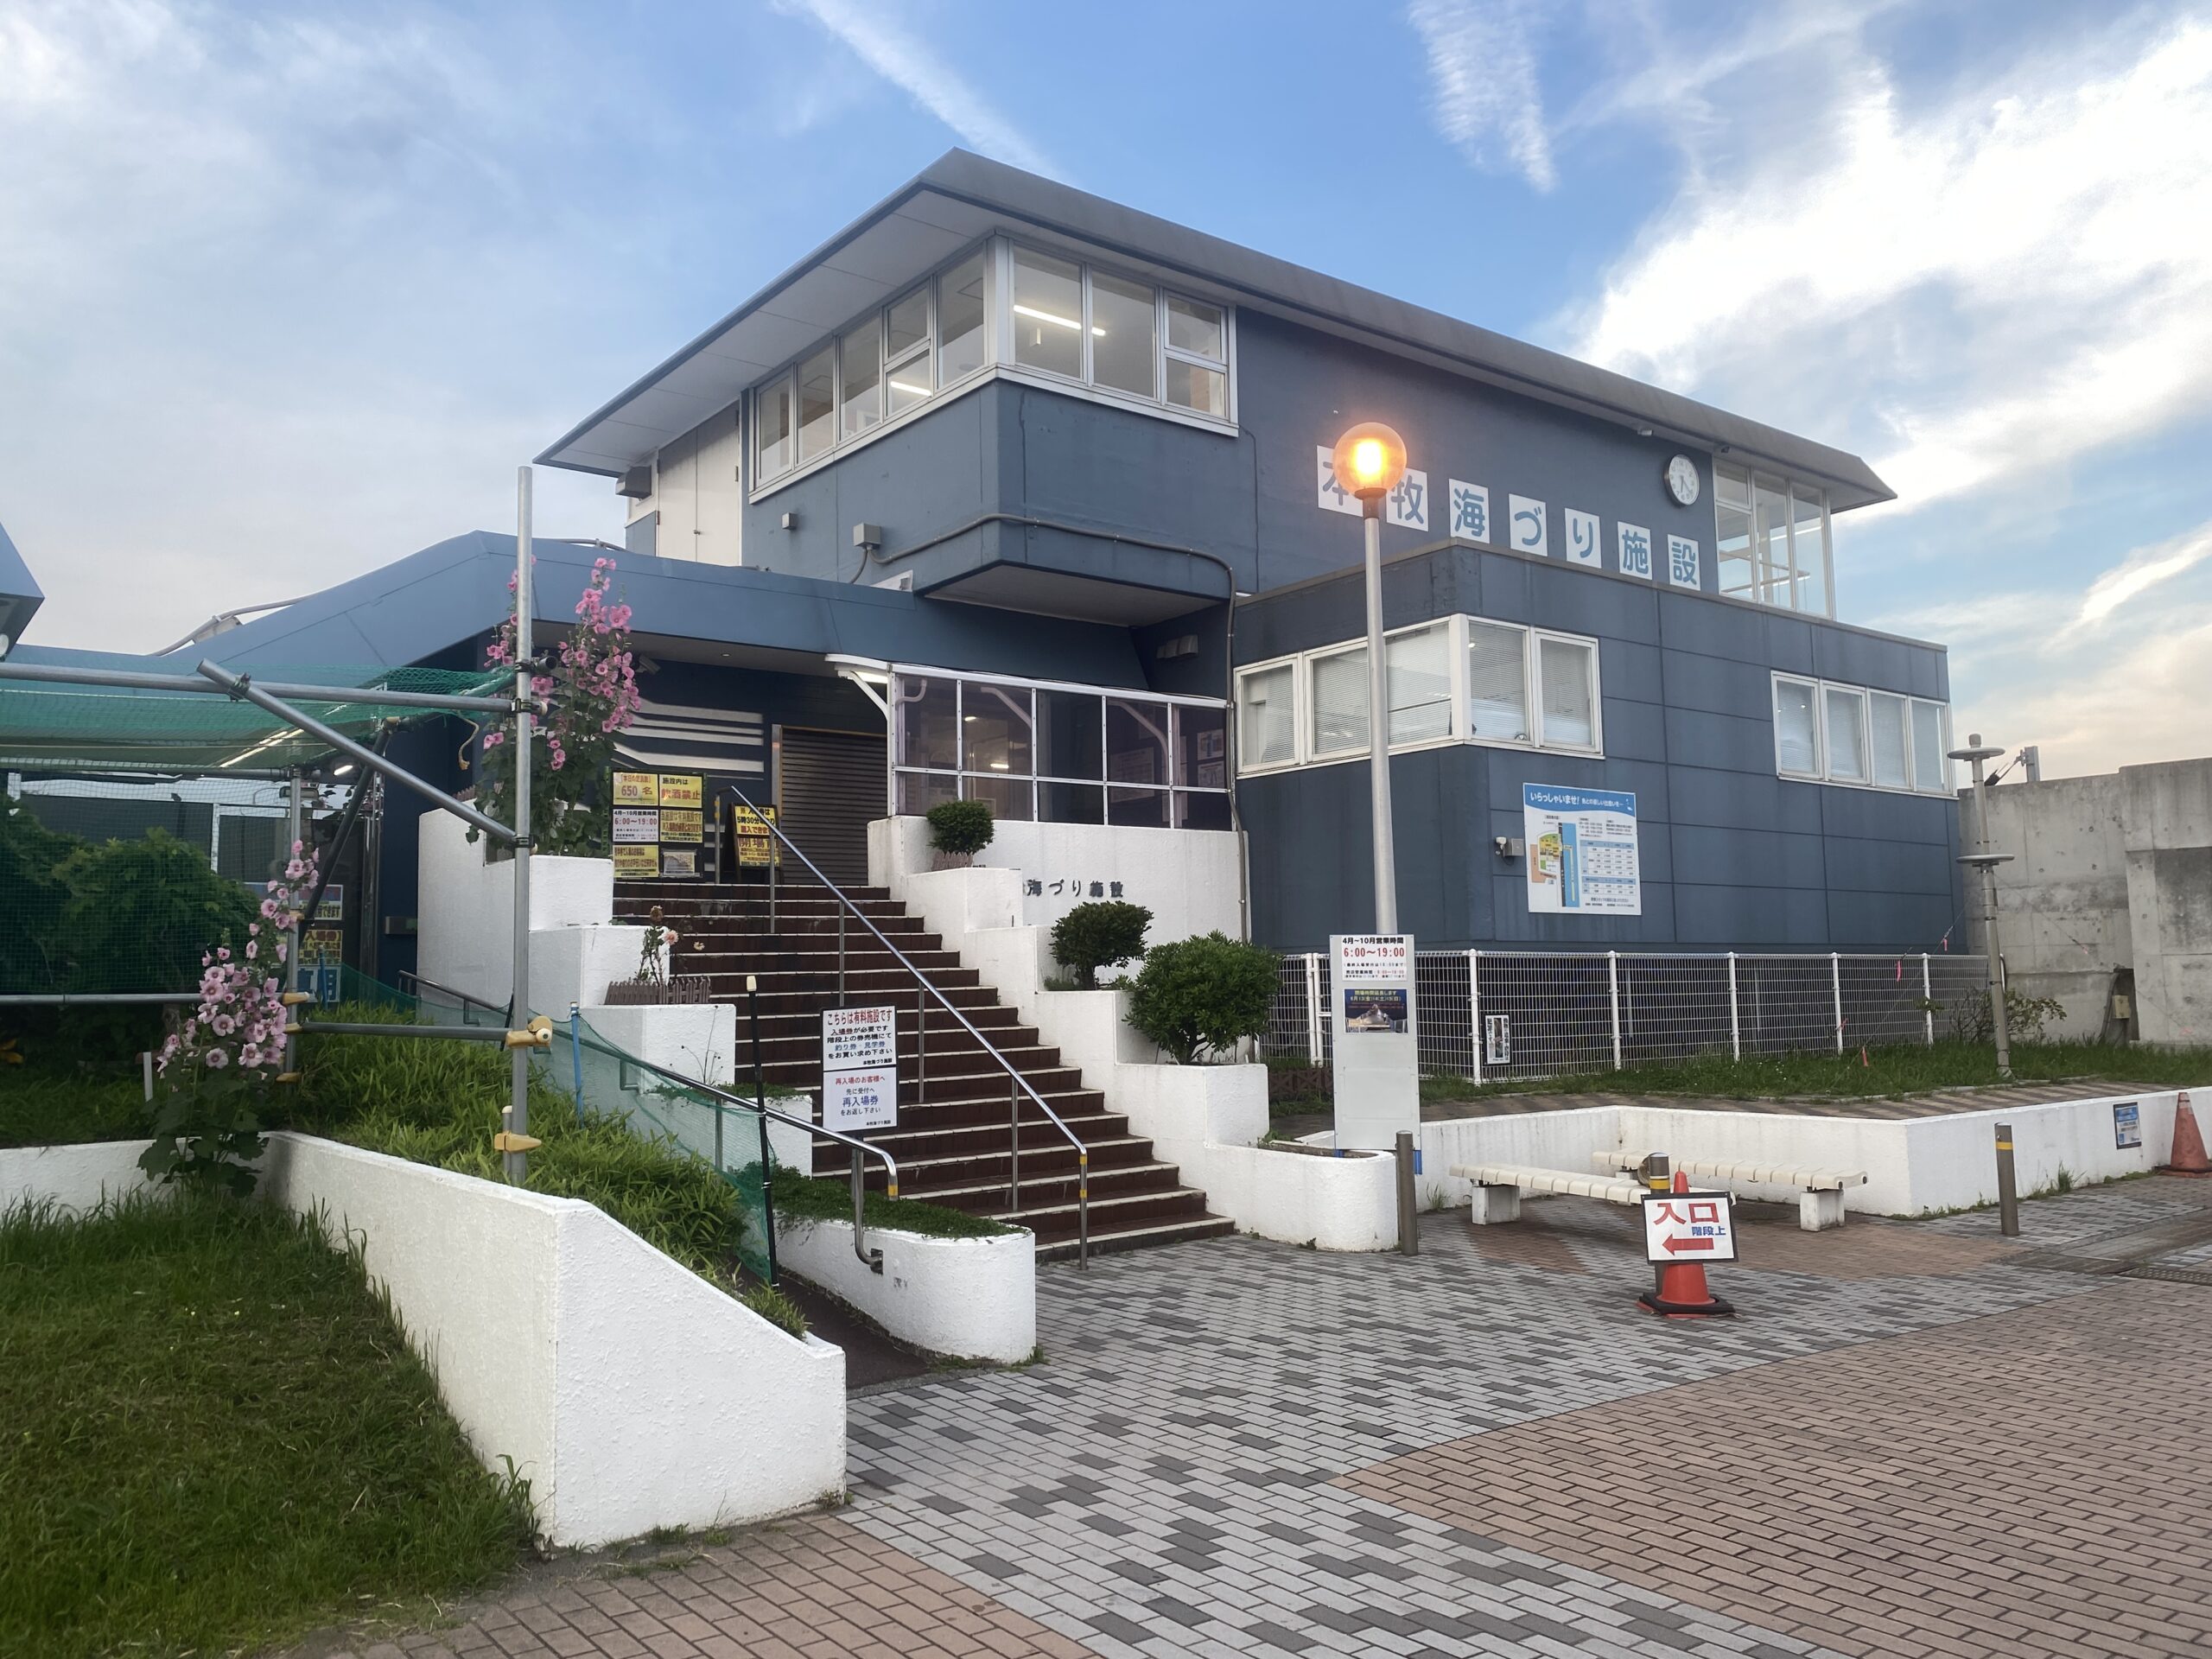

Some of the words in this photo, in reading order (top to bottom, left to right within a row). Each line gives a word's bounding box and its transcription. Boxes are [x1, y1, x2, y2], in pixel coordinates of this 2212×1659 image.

[622, 785, 638, 796] 650
[642, 786, 652, 795] 名
[827, 1009, 893, 1026] こちらは有料施設です
[830, 1025, 888, 1035] 入場券が必要です
[827, 1033, 892, 1044] 階段上の券売機にて
[828, 1048, 893, 1059] をお買い求め下さい
[836, 1075, 886, 1085] 再入場のお客様へ
[842, 1095, 879, 1108] 再入場券
[841, 1108, 881, 1116] をお返し下さい
[1654, 1202, 1720, 1225] 入口
[1691, 1225, 1726, 1236] 階段上
